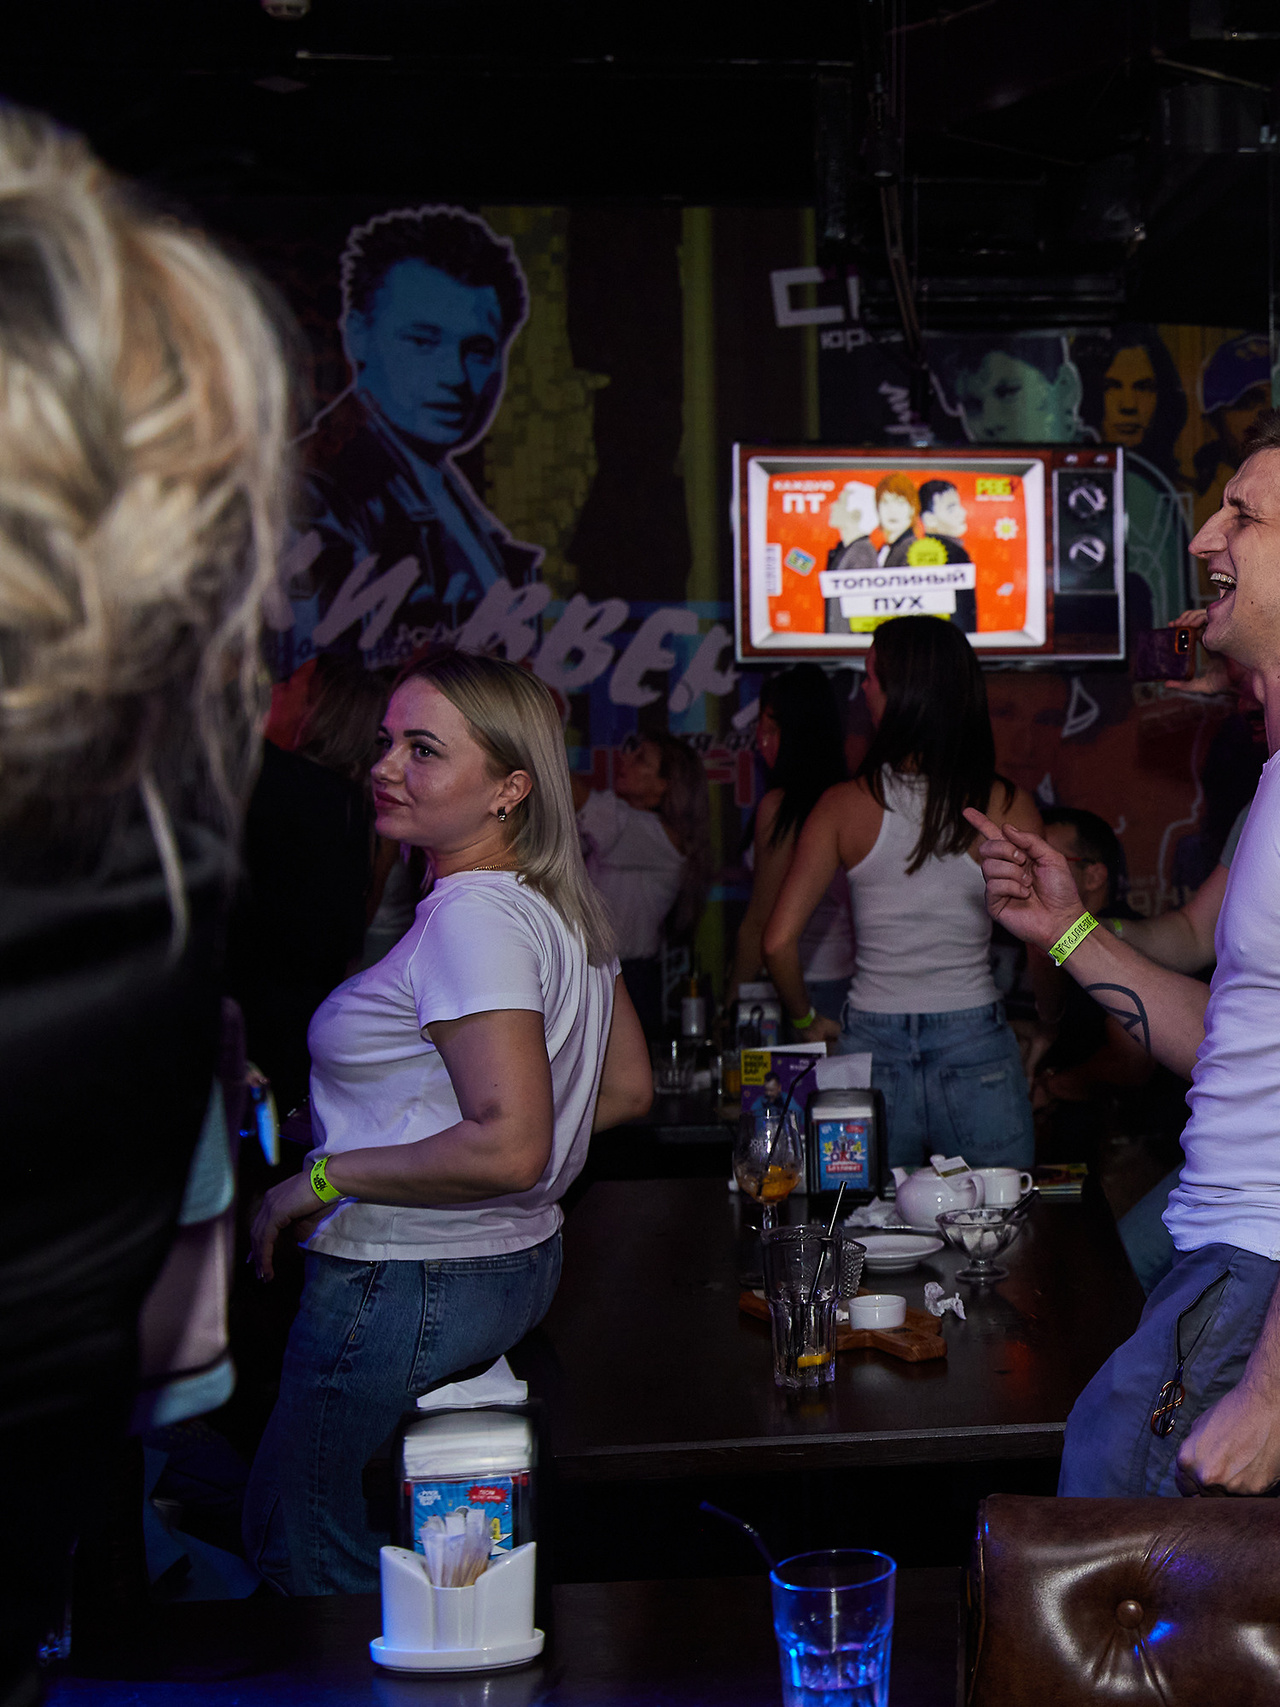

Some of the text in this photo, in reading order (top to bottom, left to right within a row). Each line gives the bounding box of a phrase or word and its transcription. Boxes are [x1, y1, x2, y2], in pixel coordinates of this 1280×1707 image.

[783, 492, 826, 514] ПТ
[832, 570, 966, 590] ТОПОЛИНЫЙ
[874, 595, 923, 611] ПУХ
[455, 575, 763, 730] ВВЕР
